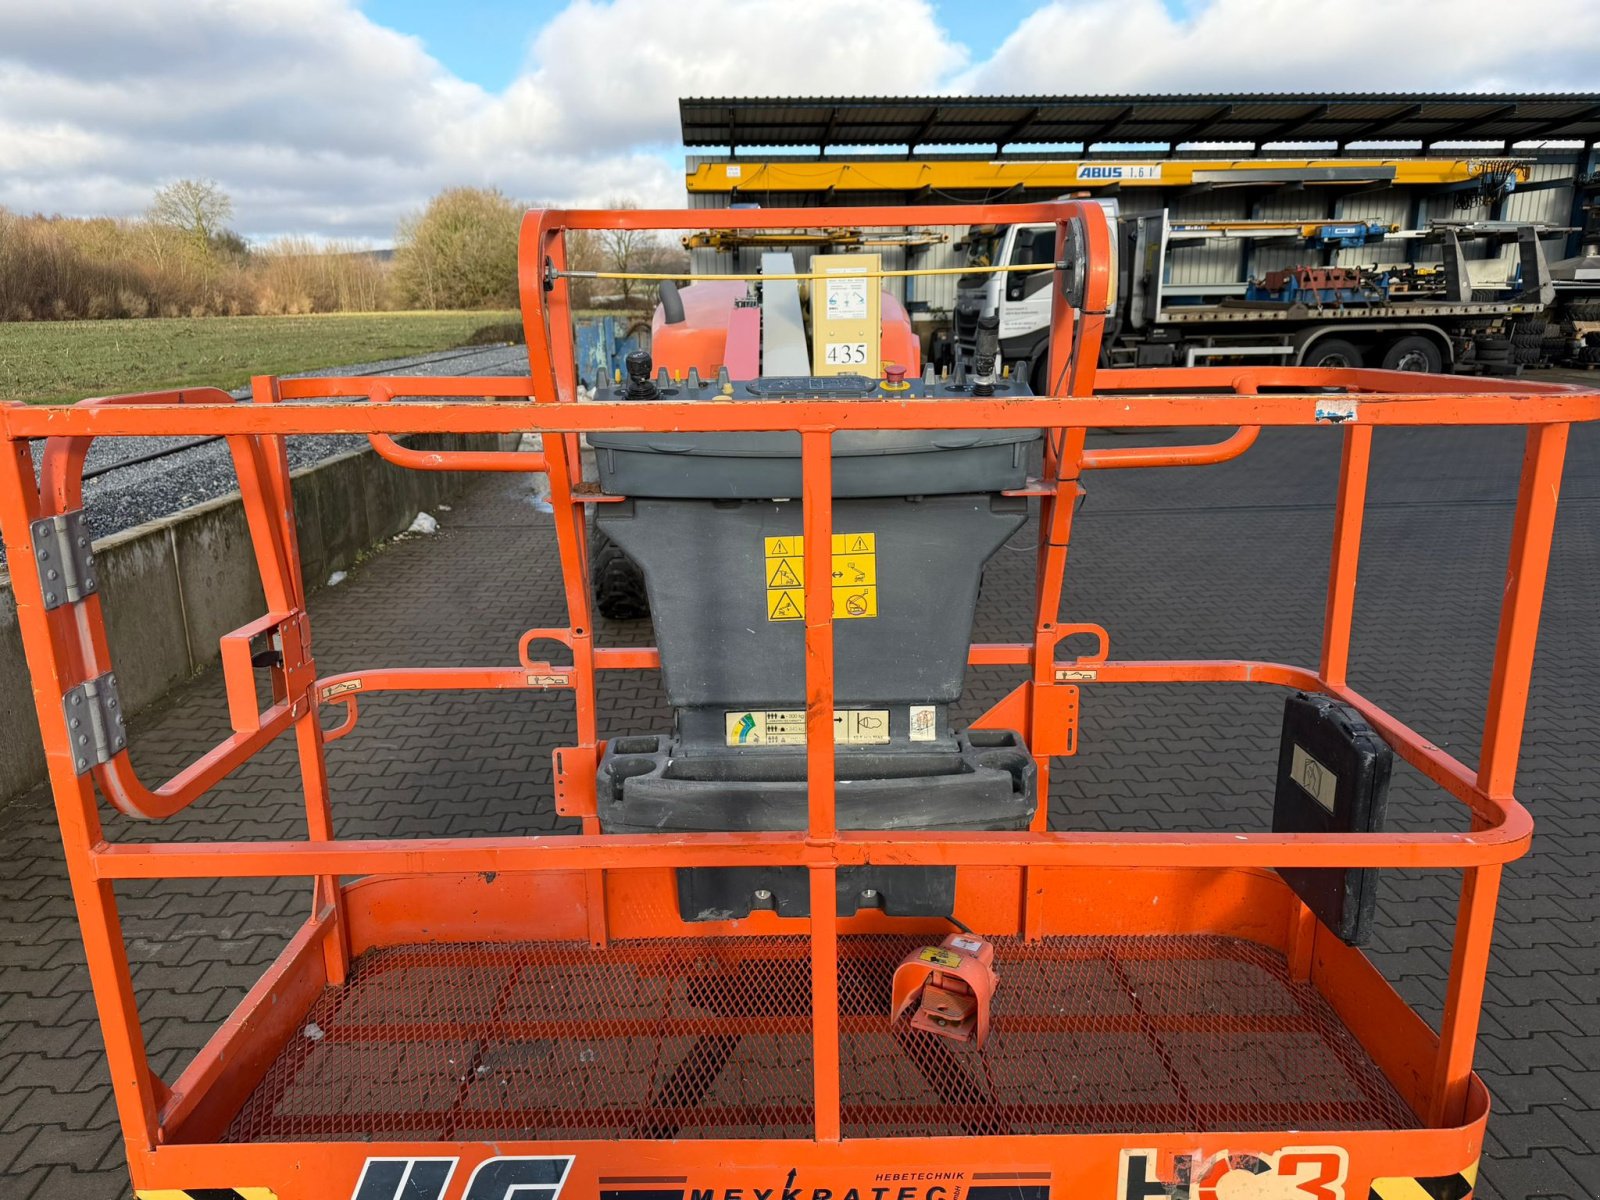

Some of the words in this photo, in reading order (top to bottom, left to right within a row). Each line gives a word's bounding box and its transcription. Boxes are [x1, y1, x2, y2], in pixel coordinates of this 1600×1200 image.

[1078, 167, 1122, 178] ABUS
[828, 344, 865, 363] 435
[875, 1172, 965, 1181] HEBETECHNIK
